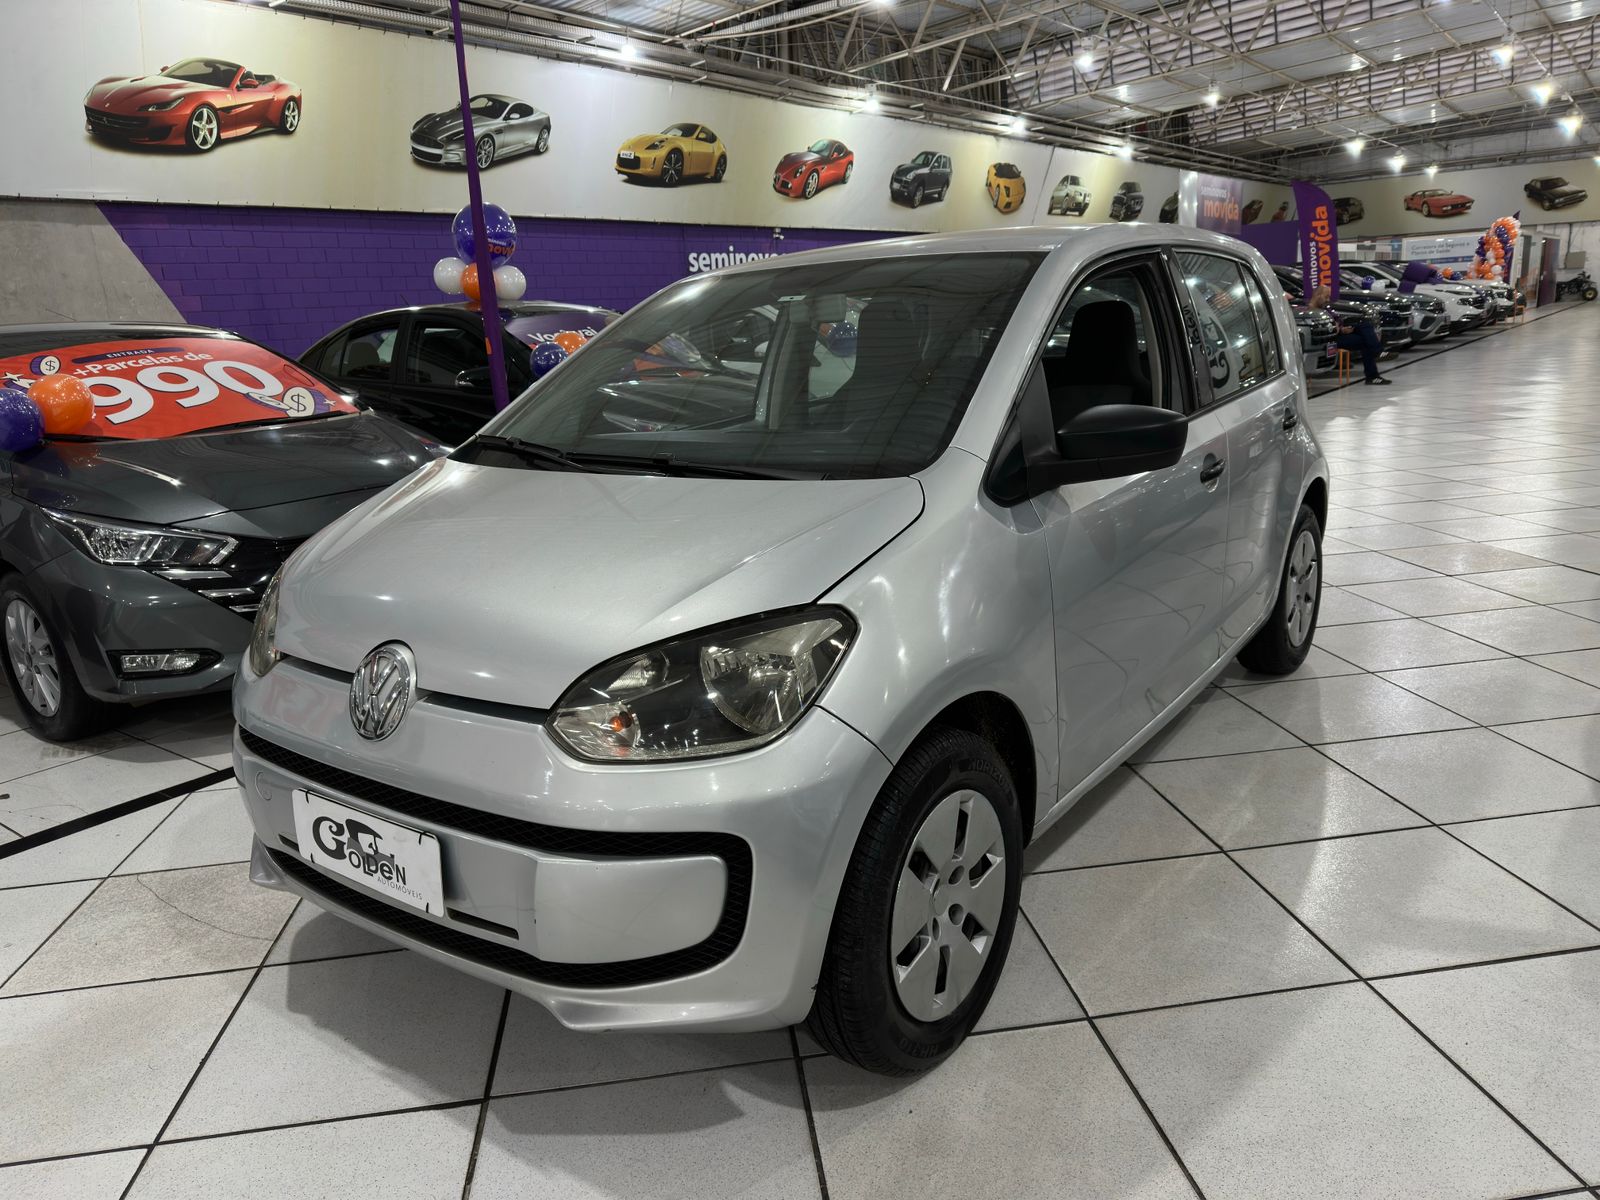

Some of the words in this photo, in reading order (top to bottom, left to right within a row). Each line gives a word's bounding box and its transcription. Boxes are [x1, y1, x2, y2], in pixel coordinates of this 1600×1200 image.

[1203, 192, 1239, 223] movida
[106, 349, 155, 358] ENTRADA
[183, 352, 214, 361] de
